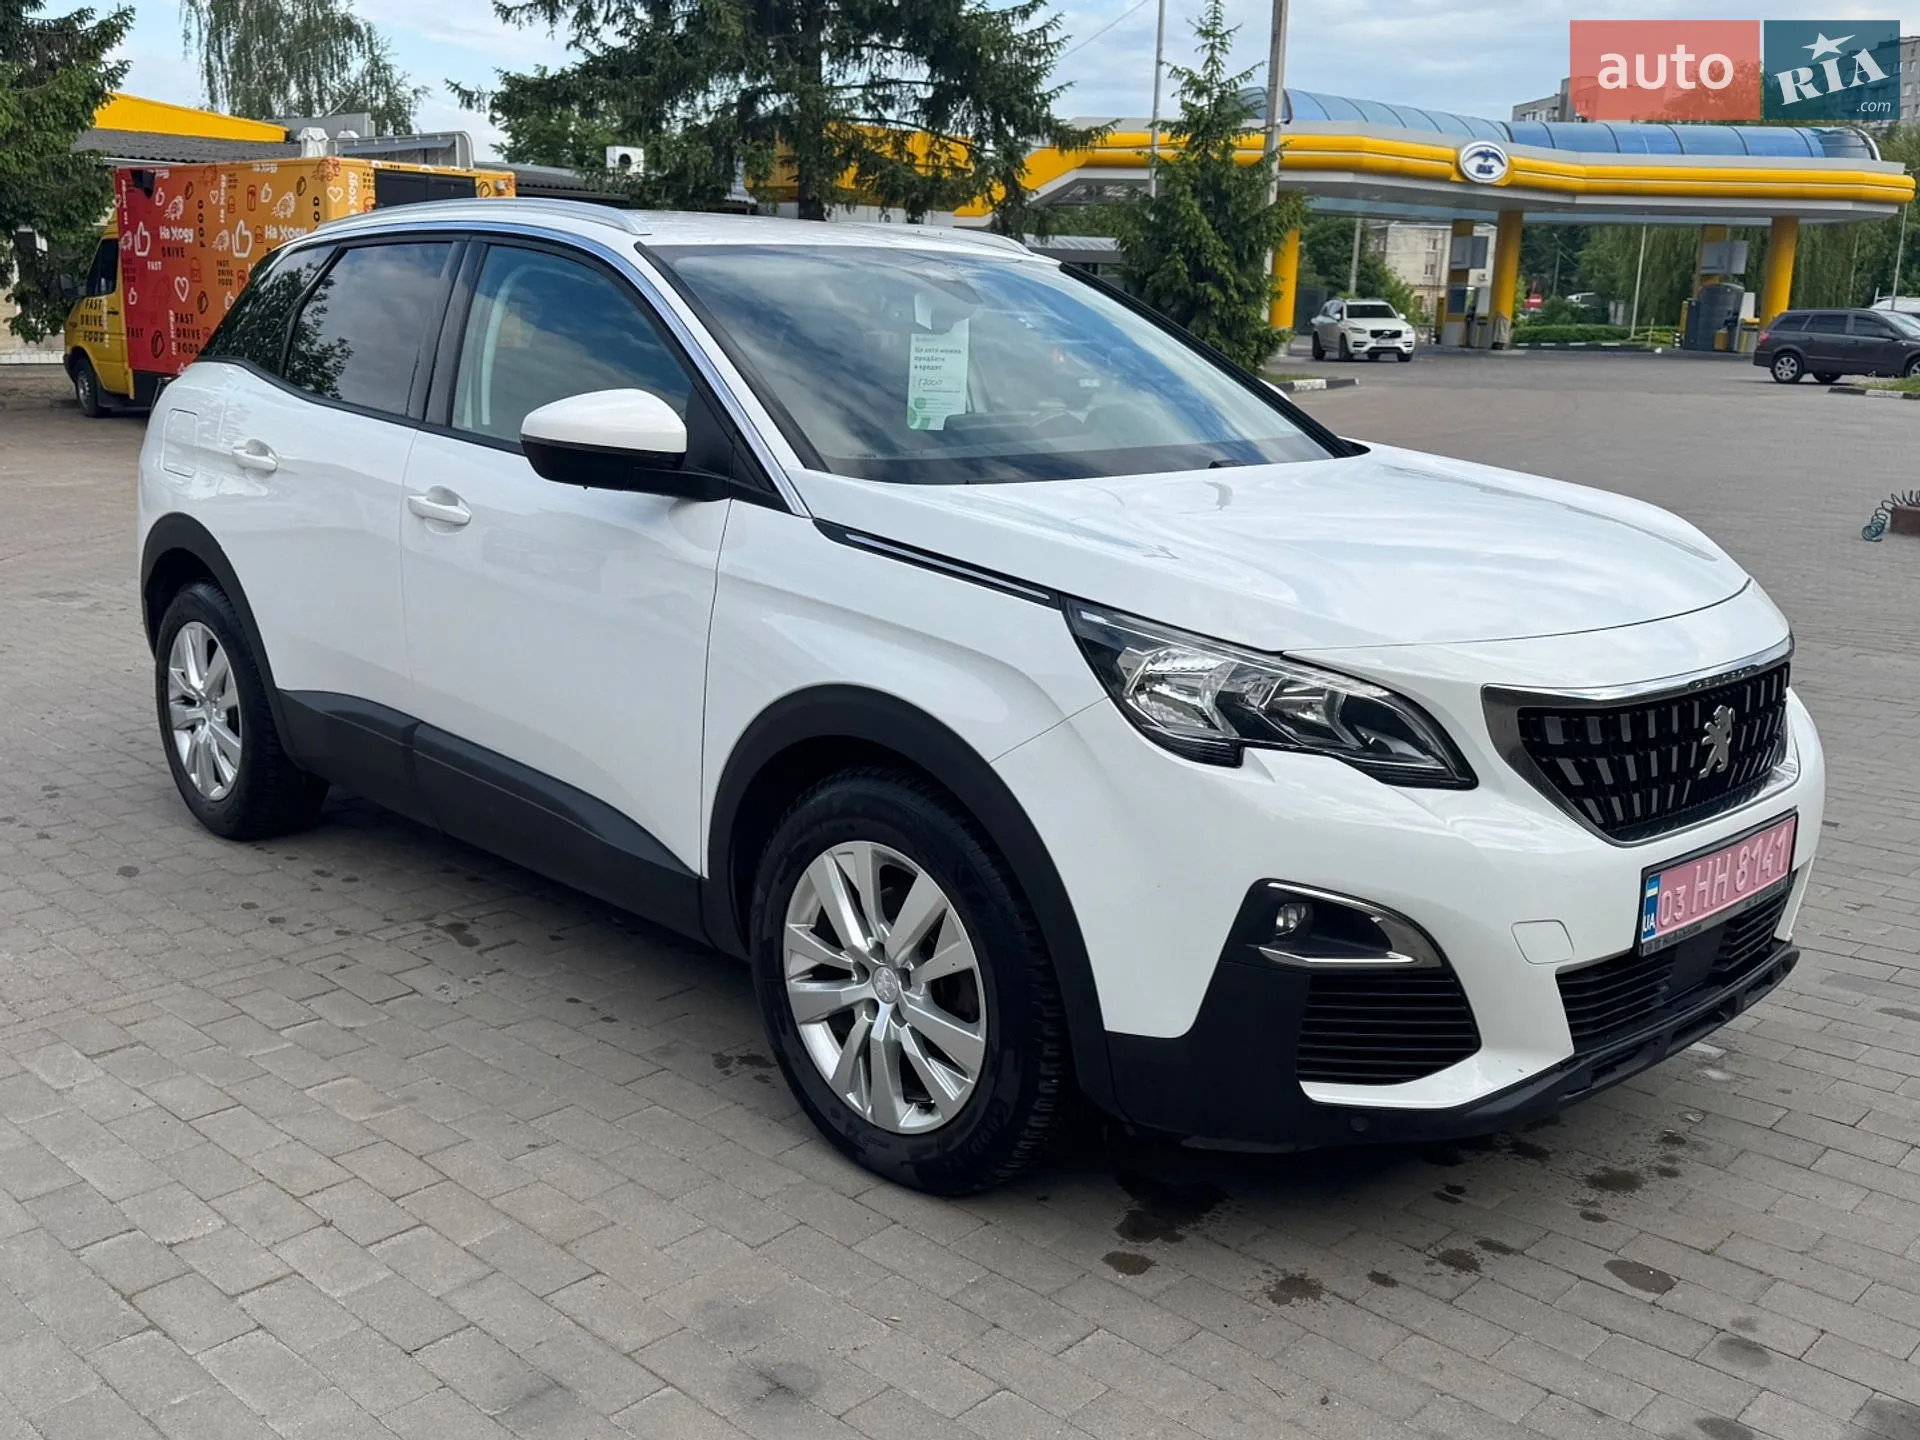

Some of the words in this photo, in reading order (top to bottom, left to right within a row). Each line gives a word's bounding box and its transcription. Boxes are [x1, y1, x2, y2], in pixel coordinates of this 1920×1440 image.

[161, 246, 185, 258] DRIVE
[147, 260, 162, 271] FAST
[85, 299, 103, 311] FAST
[80, 314, 104, 327] DRIVE
[174, 312, 194, 324] FAST
[84, 331, 106, 343] FOOD
[176, 328, 201, 339] DRIVE
[1642, 912, 1656, 933] UA
